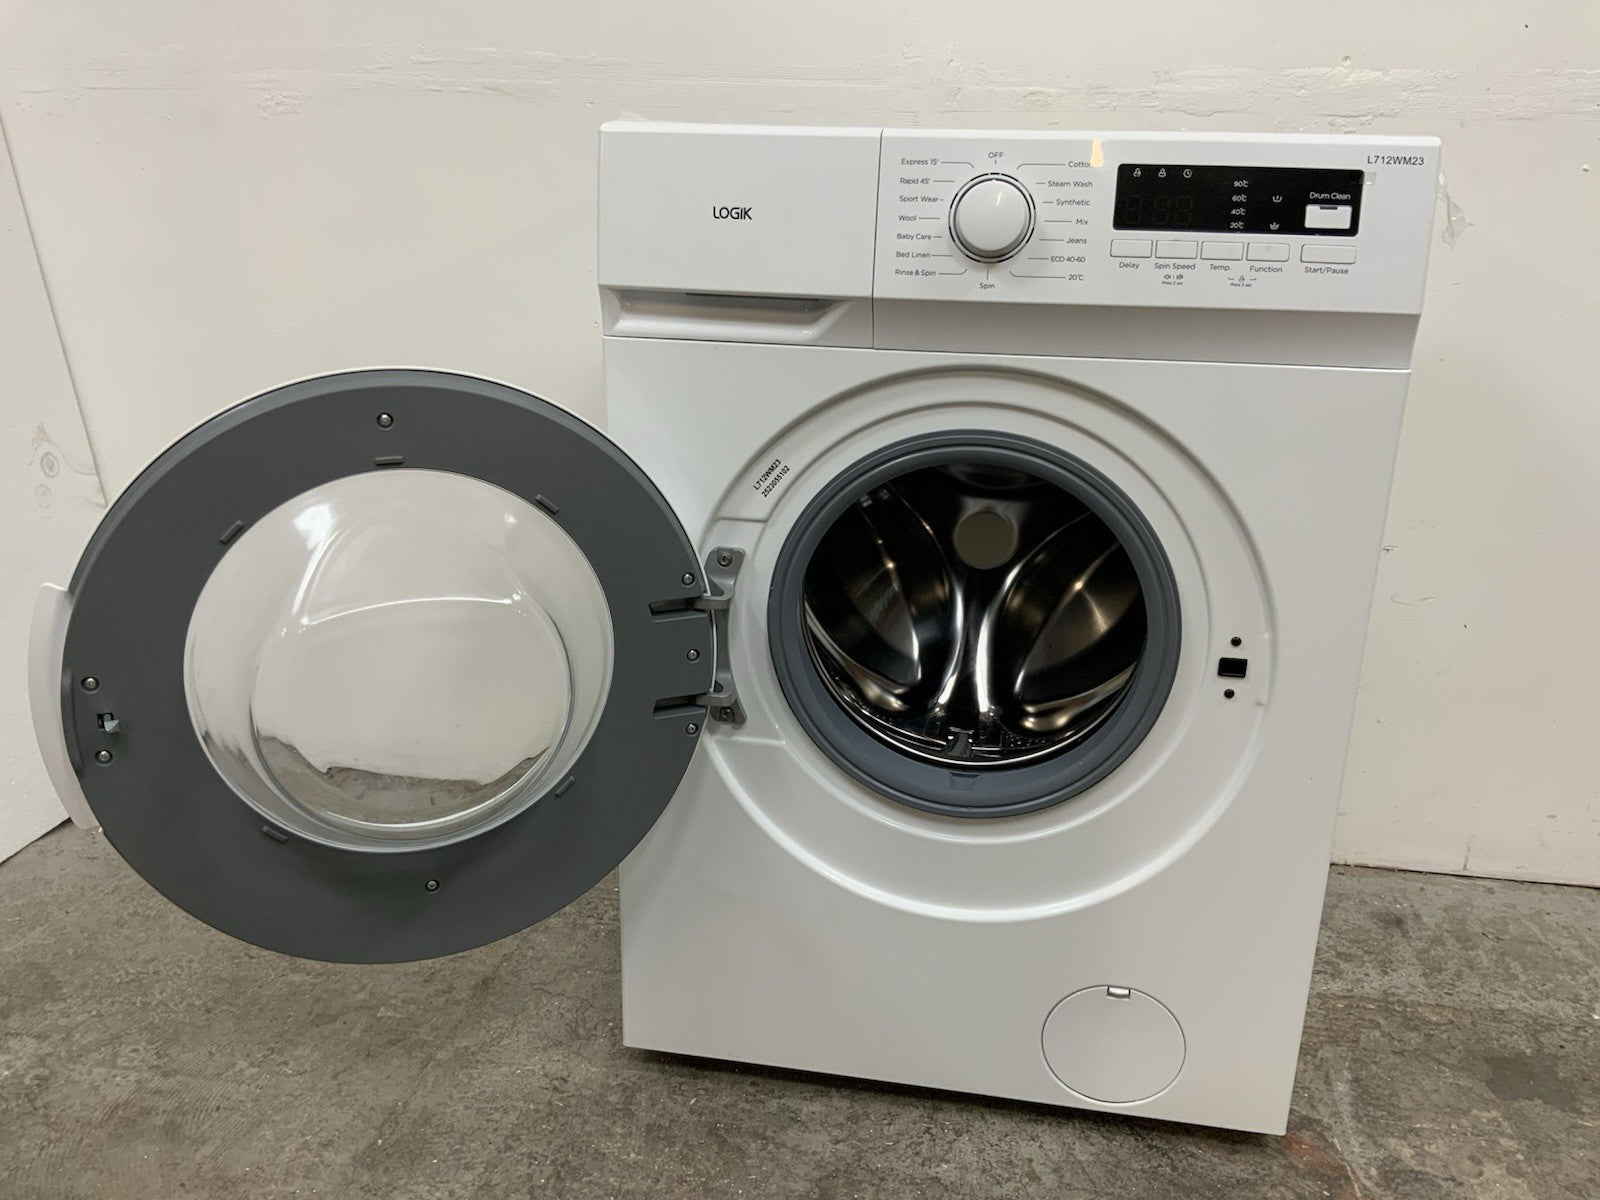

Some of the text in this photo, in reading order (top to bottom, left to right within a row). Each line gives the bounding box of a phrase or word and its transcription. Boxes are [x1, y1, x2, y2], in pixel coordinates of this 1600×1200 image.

[901, 159, 929, 167] Express
[1367, 155, 1425, 167] L712WM23
[900, 178, 918, 186] Rapid
[1048, 180, 1071, 188] Steam
[899, 196, 919, 204] Sport
[1309, 192, 1351, 200] Drum Clean
[1056, 198, 1090, 207] Synthetic
[712, 206, 753, 220] LOGIK
[897, 233, 915, 241] Baby
[896, 251, 931, 259] Bed Linen
[1118, 261, 1140, 271] Delay
[1154, 262, 1171, 270] Spin
[1209, 263, 1231, 271] Temp.
[1249, 265, 1283, 273] Function
[1304, 265, 1349, 275] Start/Pause
[921, 269, 937, 277] Spin
[979, 282, 995, 290] Spin
[753, 459, 781, 490] L712WM23
